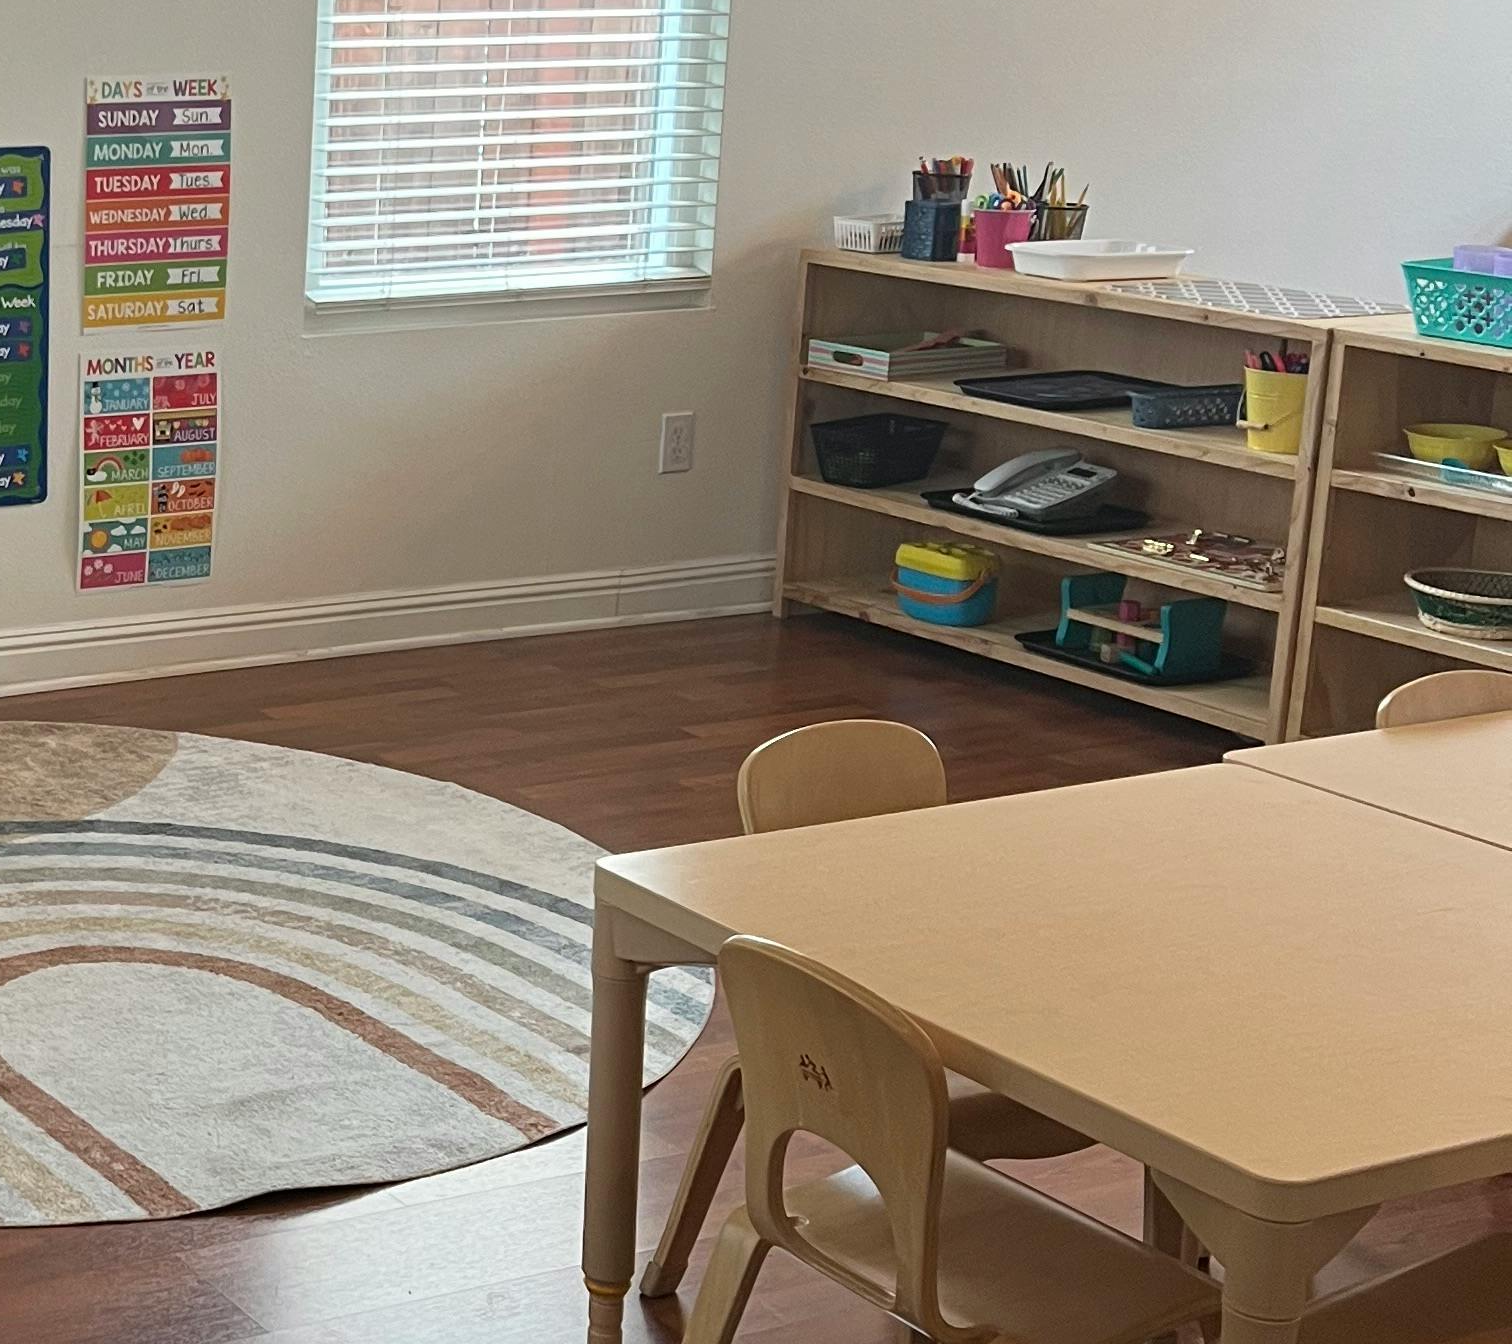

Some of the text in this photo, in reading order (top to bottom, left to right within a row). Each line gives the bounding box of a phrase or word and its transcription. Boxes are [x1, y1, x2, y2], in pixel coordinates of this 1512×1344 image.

[102, 81, 142, 99] DAYS
[174, 79, 218, 97] WEEK
[98, 110, 159, 128] SUNDAY
[94, 142, 213, 160] MONDAY Mon.
[95, 174, 160, 192] TUESDAY
[90, 207, 167, 224] WEDNESDAY
[89, 237, 166, 256] THURSDAY
[98, 270, 203, 288] FRIDAY Fri.
[1, 296, 36, 308] Week
[88, 301, 164, 321] SATURDAY
[87, 356, 154, 375] MONTHS
[175, 352, 215, 369] YEAR
[103, 399, 149, 412] JANUARY
[192, 393, 216, 405] JULY
[100, 434, 149, 447] FEBRUARY
[173, 427, 215, 441] AUGUST
[112, 468, 148, 481] MARCH
[158, 462, 216, 478] SEPTEMBER
[168, 496, 213, 512] OCTOBER
[124, 537, 145, 549] MAY
[156, 531, 211, 546] NOVEMBER
[115, 570, 143, 583] JUNE
[156, 564, 209, 578] DECEMBER
